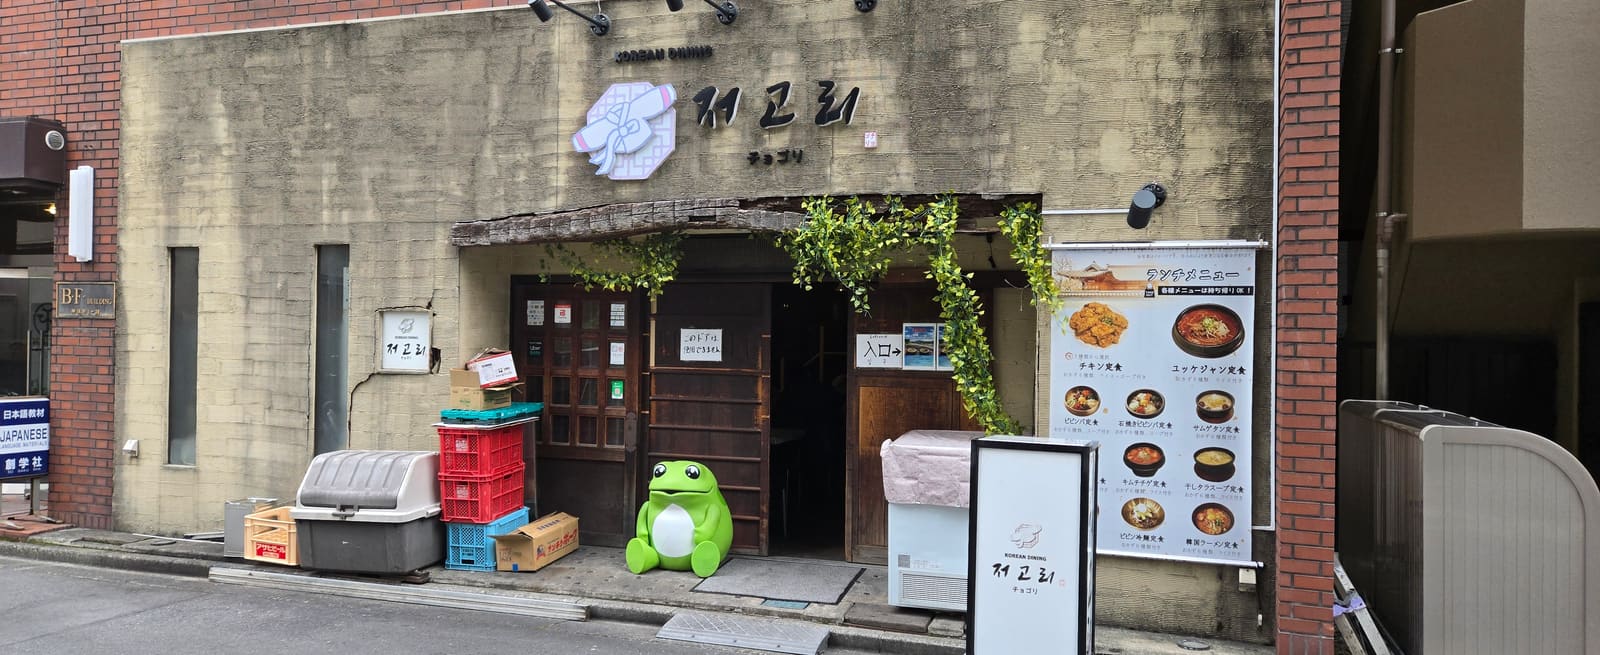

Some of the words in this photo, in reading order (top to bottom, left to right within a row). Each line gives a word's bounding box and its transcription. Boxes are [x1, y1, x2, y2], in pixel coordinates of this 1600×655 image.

[614, 48, 664, 63] KOREAN
[668, 45, 712, 60] DINING
[693, 80, 862, 130] 저고리
[747, 149, 803, 166] チョゴリ
[1147, 268, 1240, 282] ランチメニュー
[87, 297, 112, 305] BUILDING
[684, 332, 717, 343] このドアは
[387, 343, 426, 356] 저고리
[683, 345, 721, 355] 使用できません
[863, 340, 891, 358] 入口
[1079, 362, 1123, 372] チキン定食
[1171, 364, 1247, 376] ユッケジャン定食
[3, 408, 45, 420] 日本語教材
[1, 428, 47, 442] JAPANESE
[1193, 424, 1240, 434] サムゲタン定食
[5, 456, 42, 471] 創学社
[1122, 478, 1168, 488] キムチチゲ定食
[1184, 482, 1245, 494] 干しタラスープ定食
[256, 543, 286, 553] アサヒビール
[1185, 538, 1239, 550] 韓国ラーメン定食
[1004, 552, 1026, 560] KOREAN
[992, 562, 1055, 584] 저고리
[1012, 586, 1038, 595] チョゴリ
